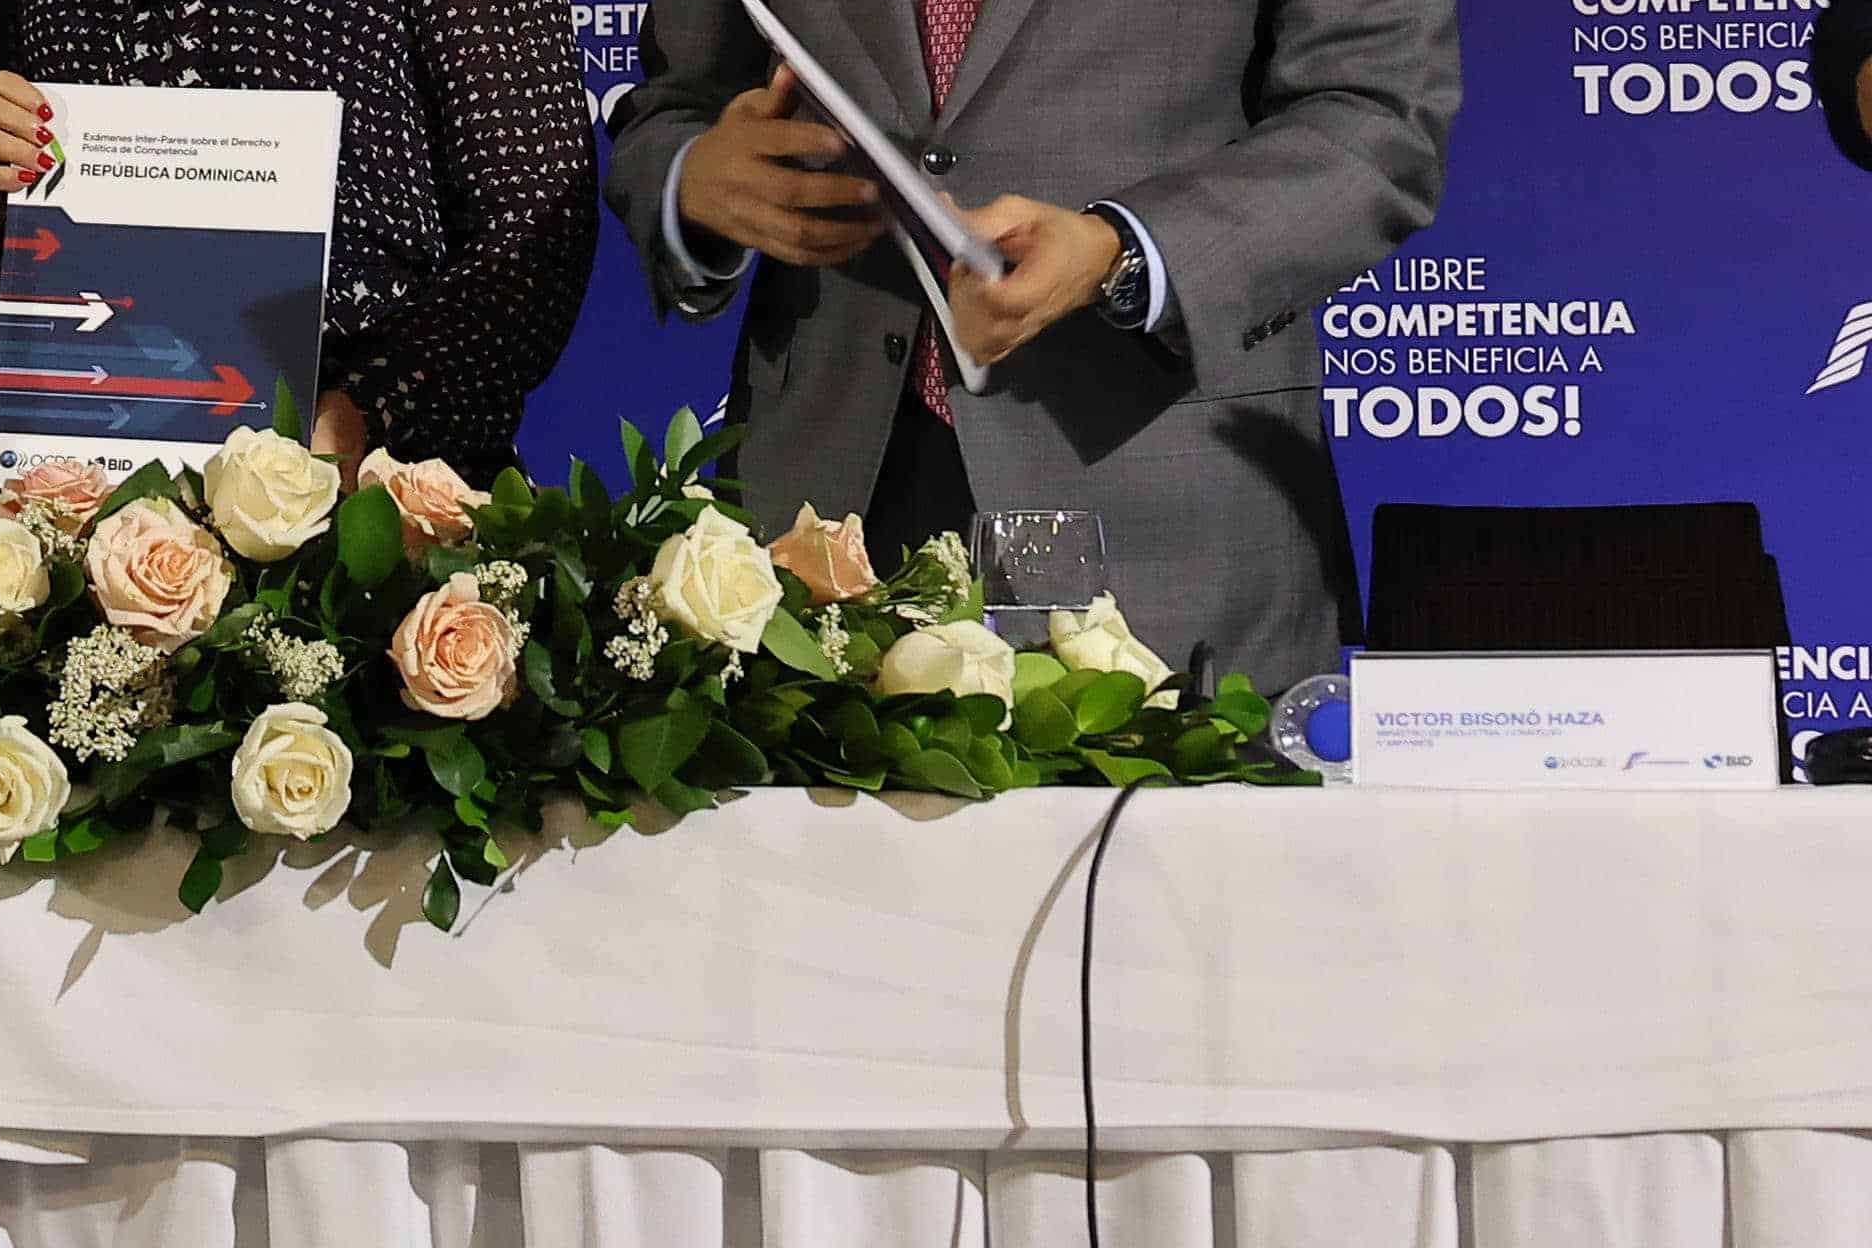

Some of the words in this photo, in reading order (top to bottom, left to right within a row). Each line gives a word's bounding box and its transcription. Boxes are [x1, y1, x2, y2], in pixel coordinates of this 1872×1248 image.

[1575, 26, 1646, 51] NOS
[1572, 60, 1824, 115] TODOS
[82, 143, 117, 153] Política
[120, 145, 132, 154] de
[134, 144, 198, 157] Competencia
[83, 132, 132, 143] Exámenes
[135, 134, 188, 145] Inter-Pares
[191, 136, 218, 146] sobre
[220, 137, 228, 146] el
[231, 137, 272, 148] Derecho
[80, 161, 170, 180] REPÚBLICA
[174, 167, 278, 183] DOMINICANA
[1396, 258, 1484, 291] LIBRE
[1322, 300, 1636, 339] COMPETENCIA
[1325, 349, 1395, 374] NOS
[1410, 347, 1568, 373] BENEFICIA
[1580, 347, 1602, 371] A
[1324, 385, 1580, 437] TODOS!
[108, 459, 133, 471] BID
[1376, 712, 1453, 726] VICTOR
[1460, 706, 1541, 727] BISONÓ
[1548, 712, 1605, 726] HAZA
